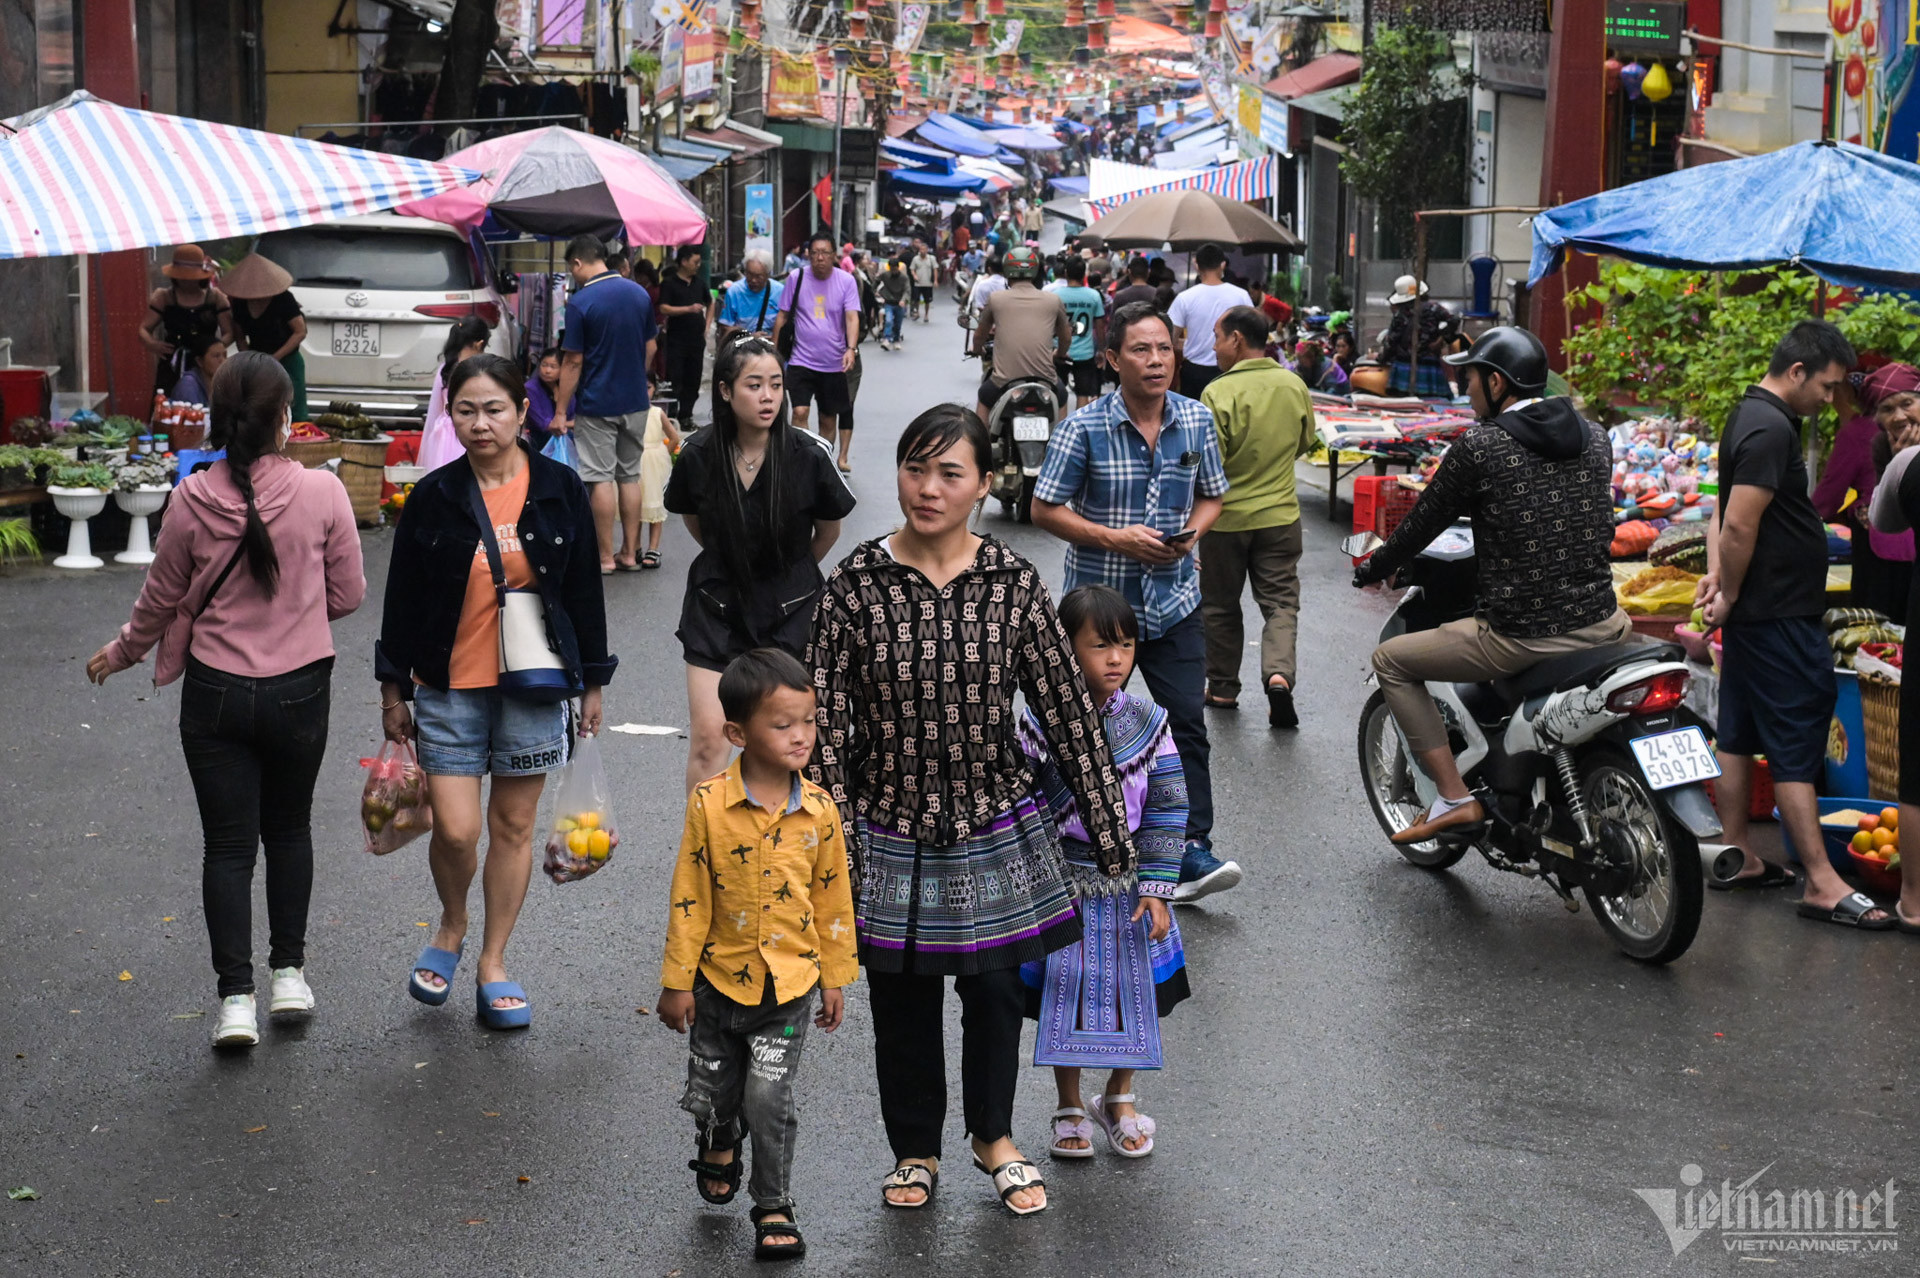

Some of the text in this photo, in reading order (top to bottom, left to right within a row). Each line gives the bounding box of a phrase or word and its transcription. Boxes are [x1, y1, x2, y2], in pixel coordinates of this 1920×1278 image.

[345, 322, 369, 339] 30E
[334, 339, 378, 354] 823.24
[1643, 733, 1698, 761] 24-B2
[1646, 754, 1715, 786] 599.79
